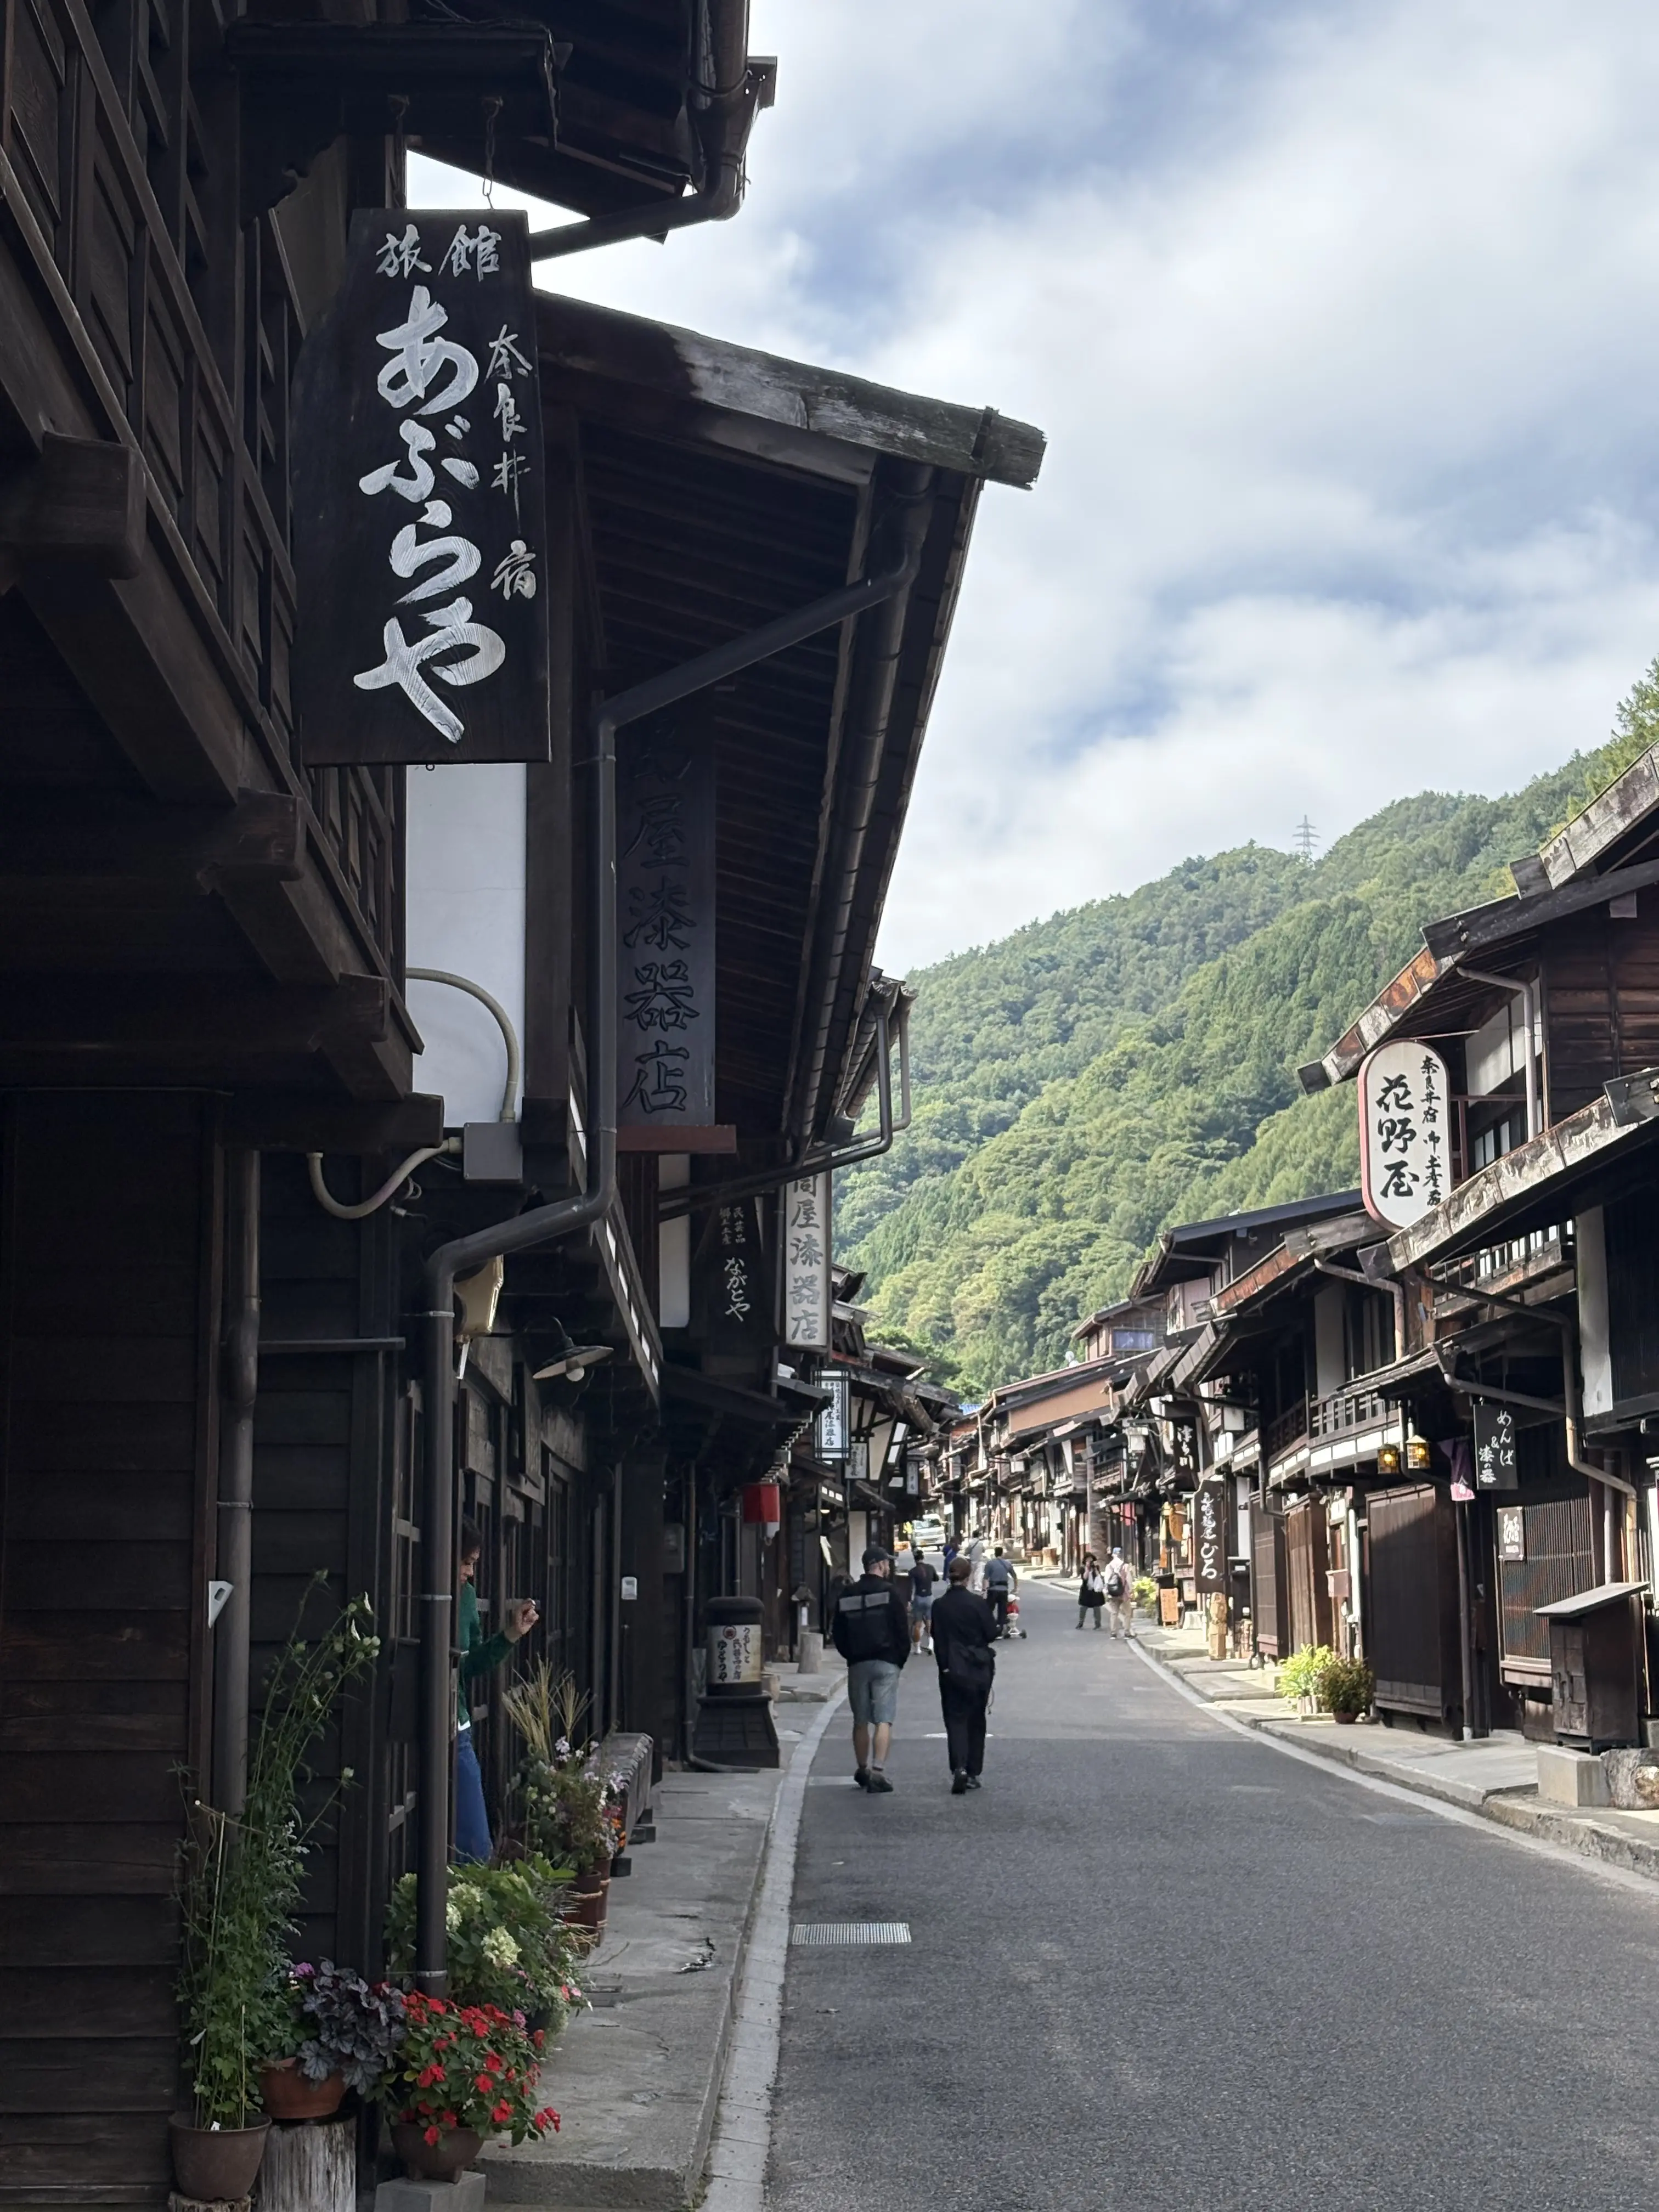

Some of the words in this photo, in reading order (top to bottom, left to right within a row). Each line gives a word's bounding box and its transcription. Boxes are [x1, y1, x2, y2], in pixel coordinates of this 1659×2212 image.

[375, 223, 502, 282] 旅館
[484, 324, 537, 600] 奈良井宿
[353, 285, 506, 744] あぶらや
[622, 718, 699, 1114] 屋漆器店
[1420, 1055, 1441, 1124] 奈良井宿
[1375, 1074, 1420, 1199] 花野屋
[724, 1257, 751, 1322] ながとや
[1479, 1444, 1497, 1483] 漆の器
[1491, 1436, 1499, 1448] &
